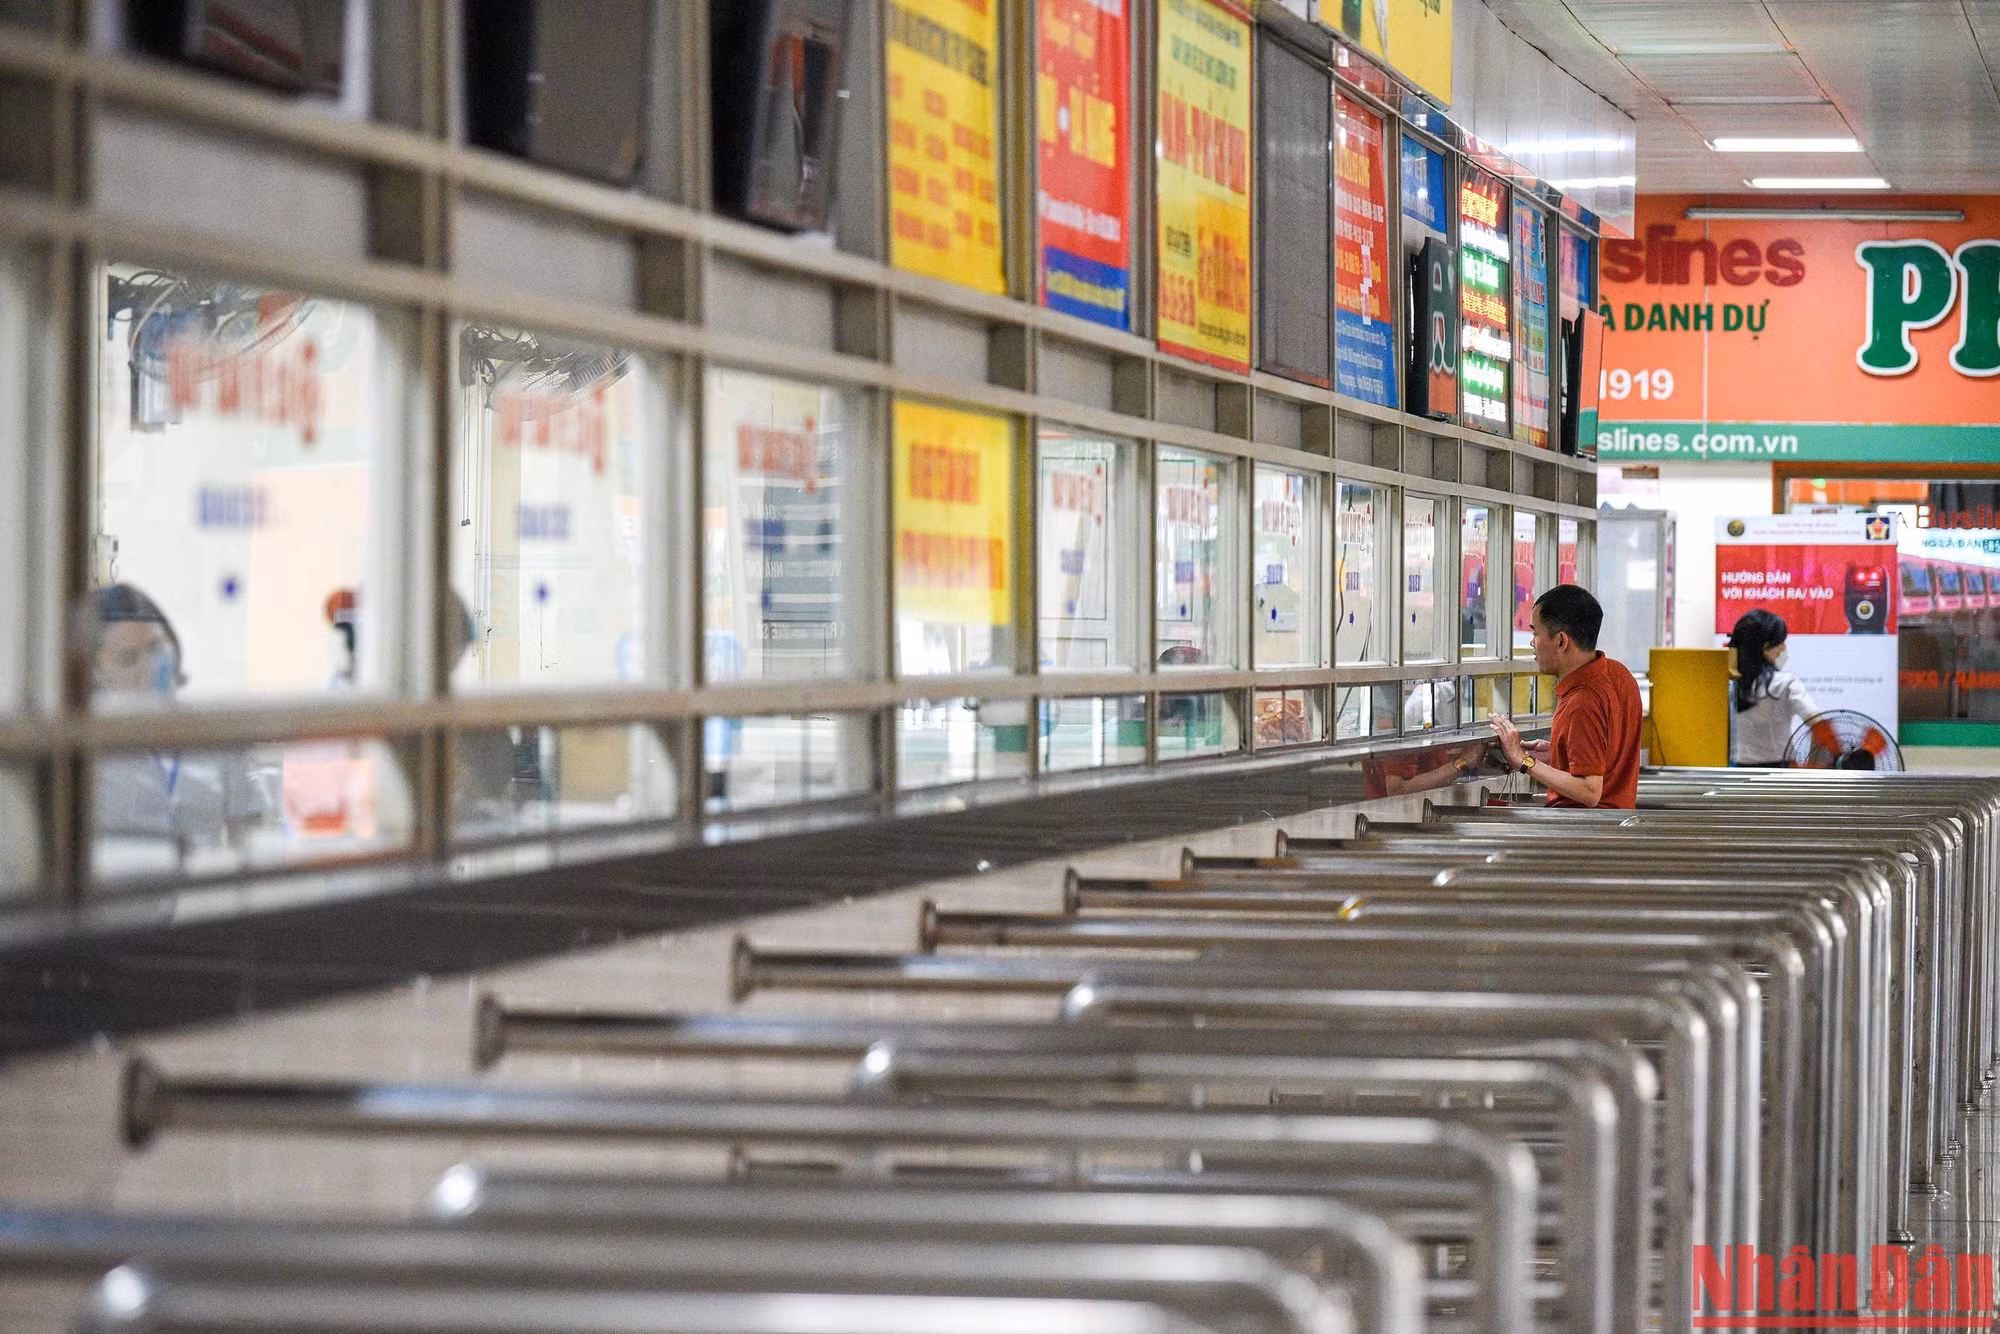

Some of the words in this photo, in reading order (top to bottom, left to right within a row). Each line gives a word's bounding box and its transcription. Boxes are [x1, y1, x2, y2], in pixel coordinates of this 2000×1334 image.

[1624, 303, 1713, 332] DANH
[1722, 298, 1770, 341] DỰ
[1915, 503, 2000, 530] Busli
[1721, 570, 1764, 584] HƯỚNG
[1744, 585, 1785, 600] KHÁCH
[1809, 584, 1835, 600] VÀO
